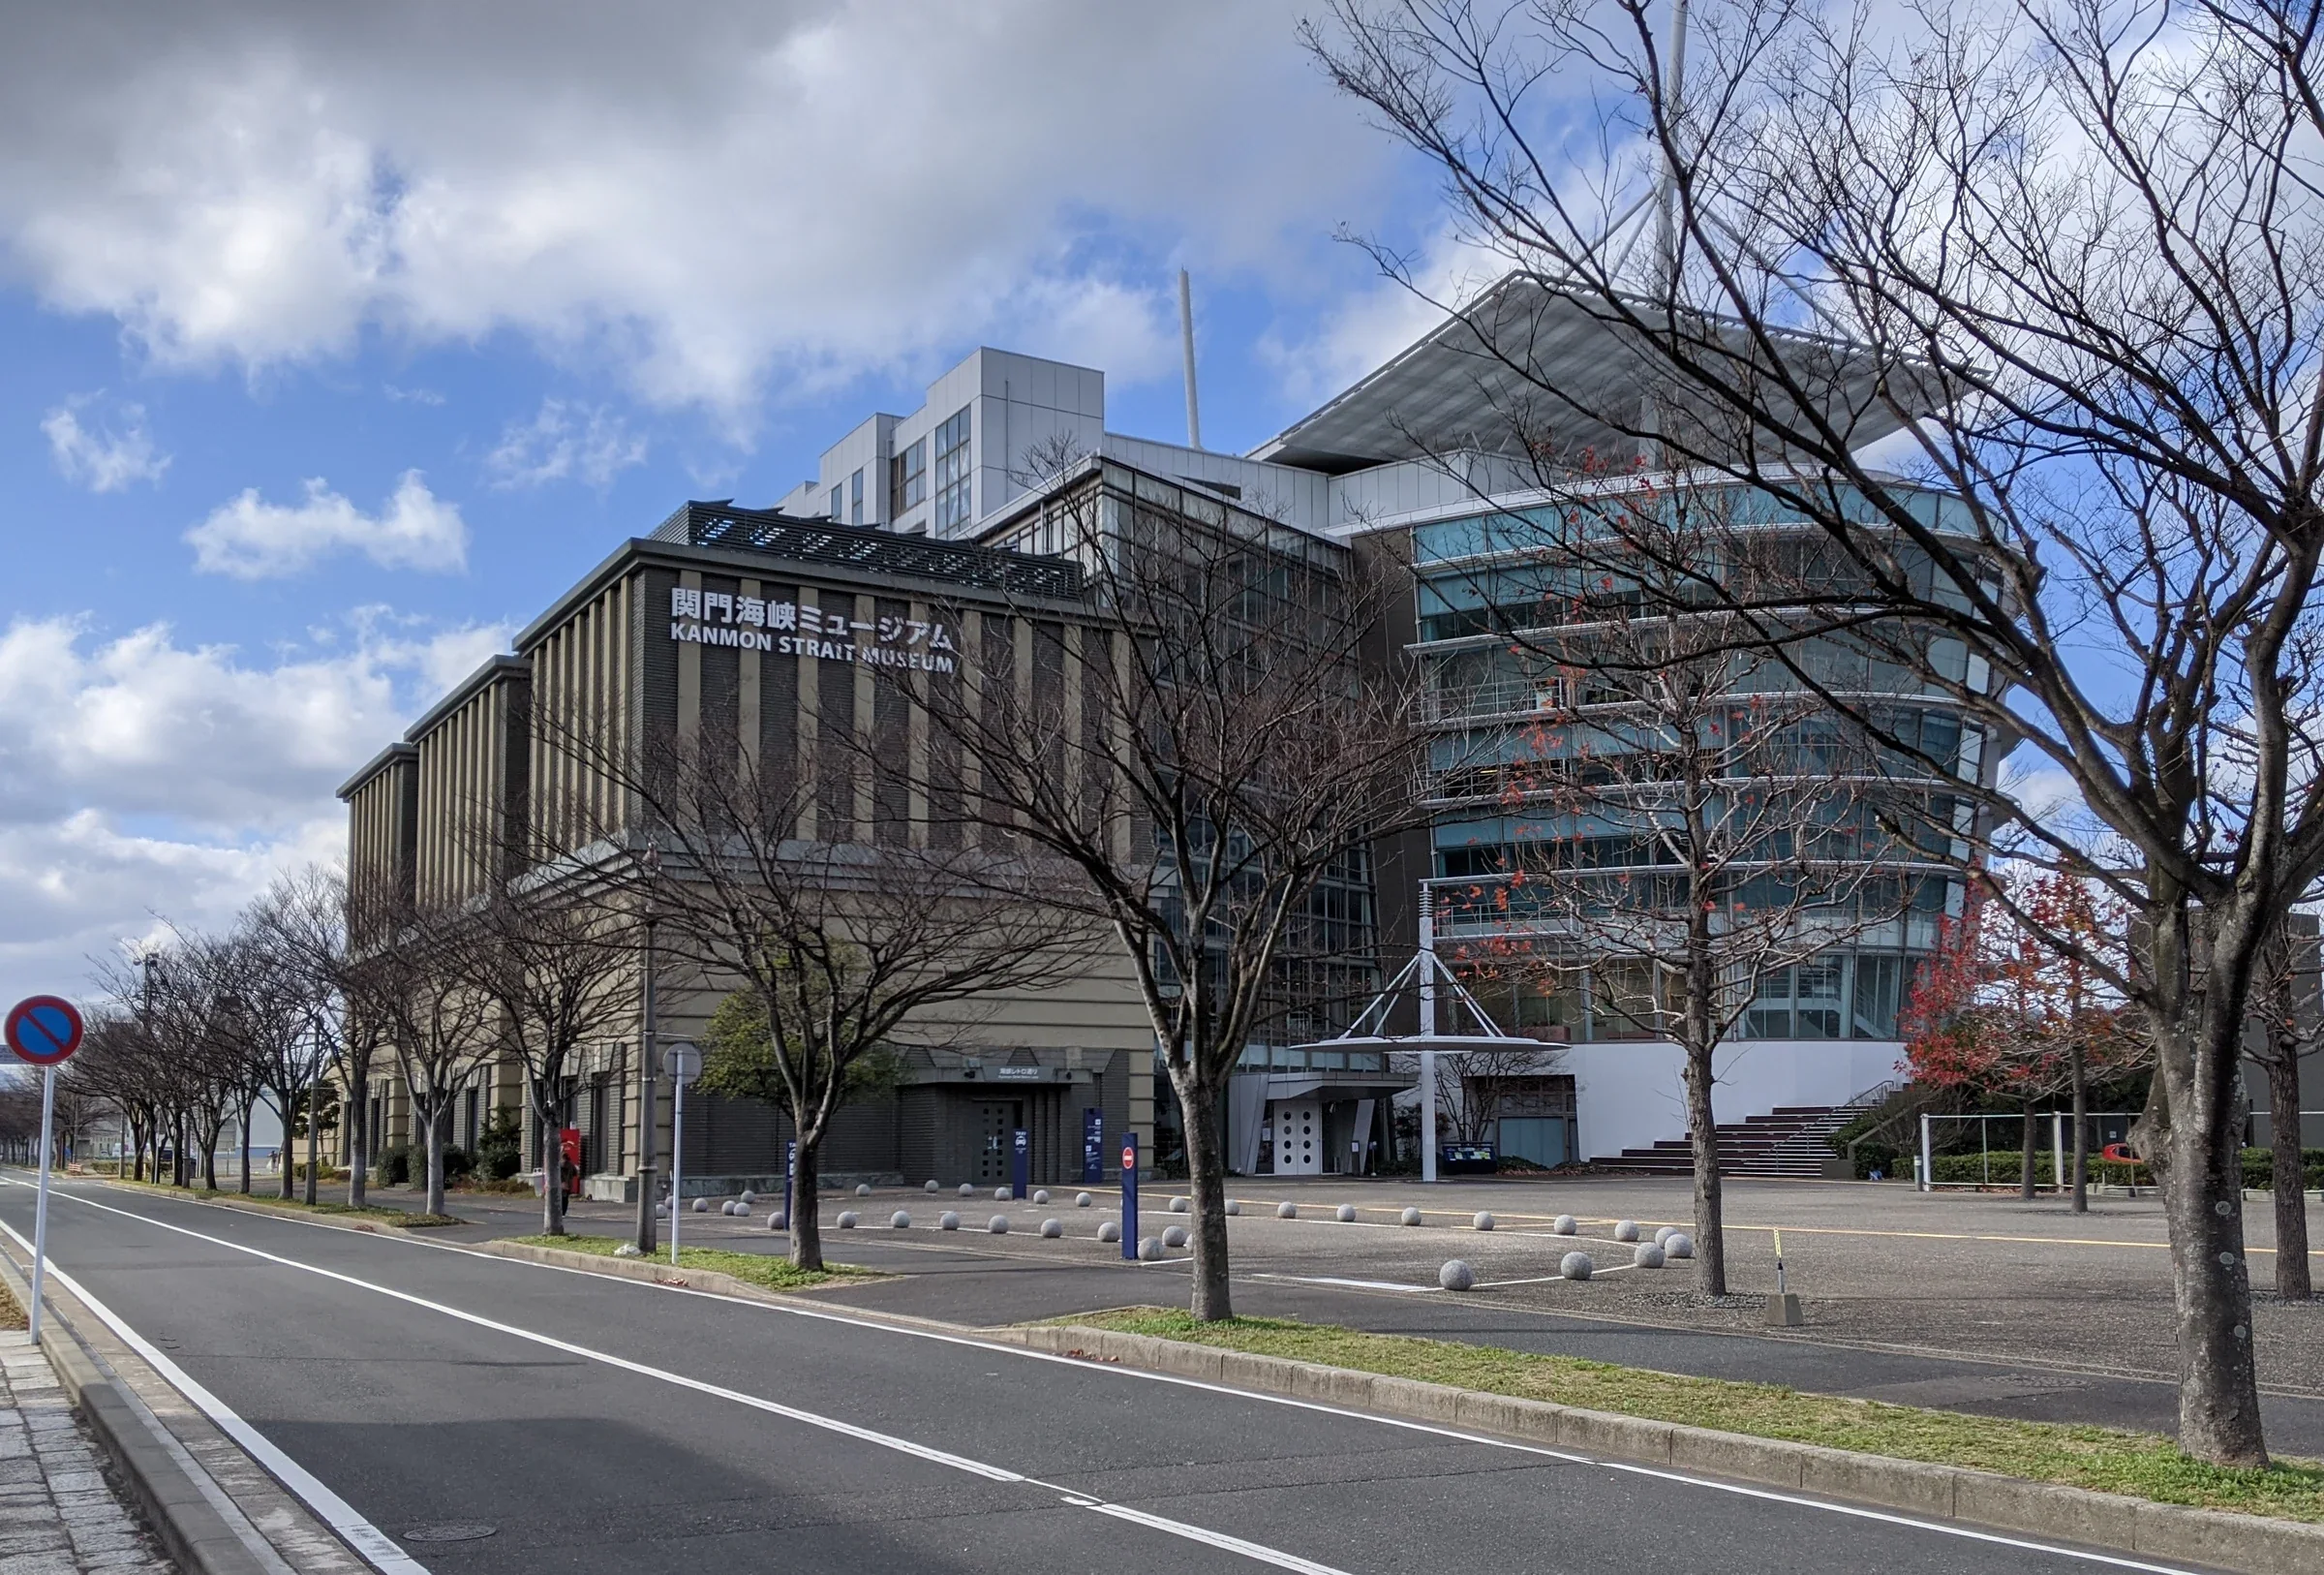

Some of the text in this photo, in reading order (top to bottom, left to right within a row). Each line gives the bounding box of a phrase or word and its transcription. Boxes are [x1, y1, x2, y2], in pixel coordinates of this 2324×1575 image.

[670, 587, 954, 651] 関門海峡ミュージアム
[670, 623, 954, 673] KANMON STRAIT MUSEUM
